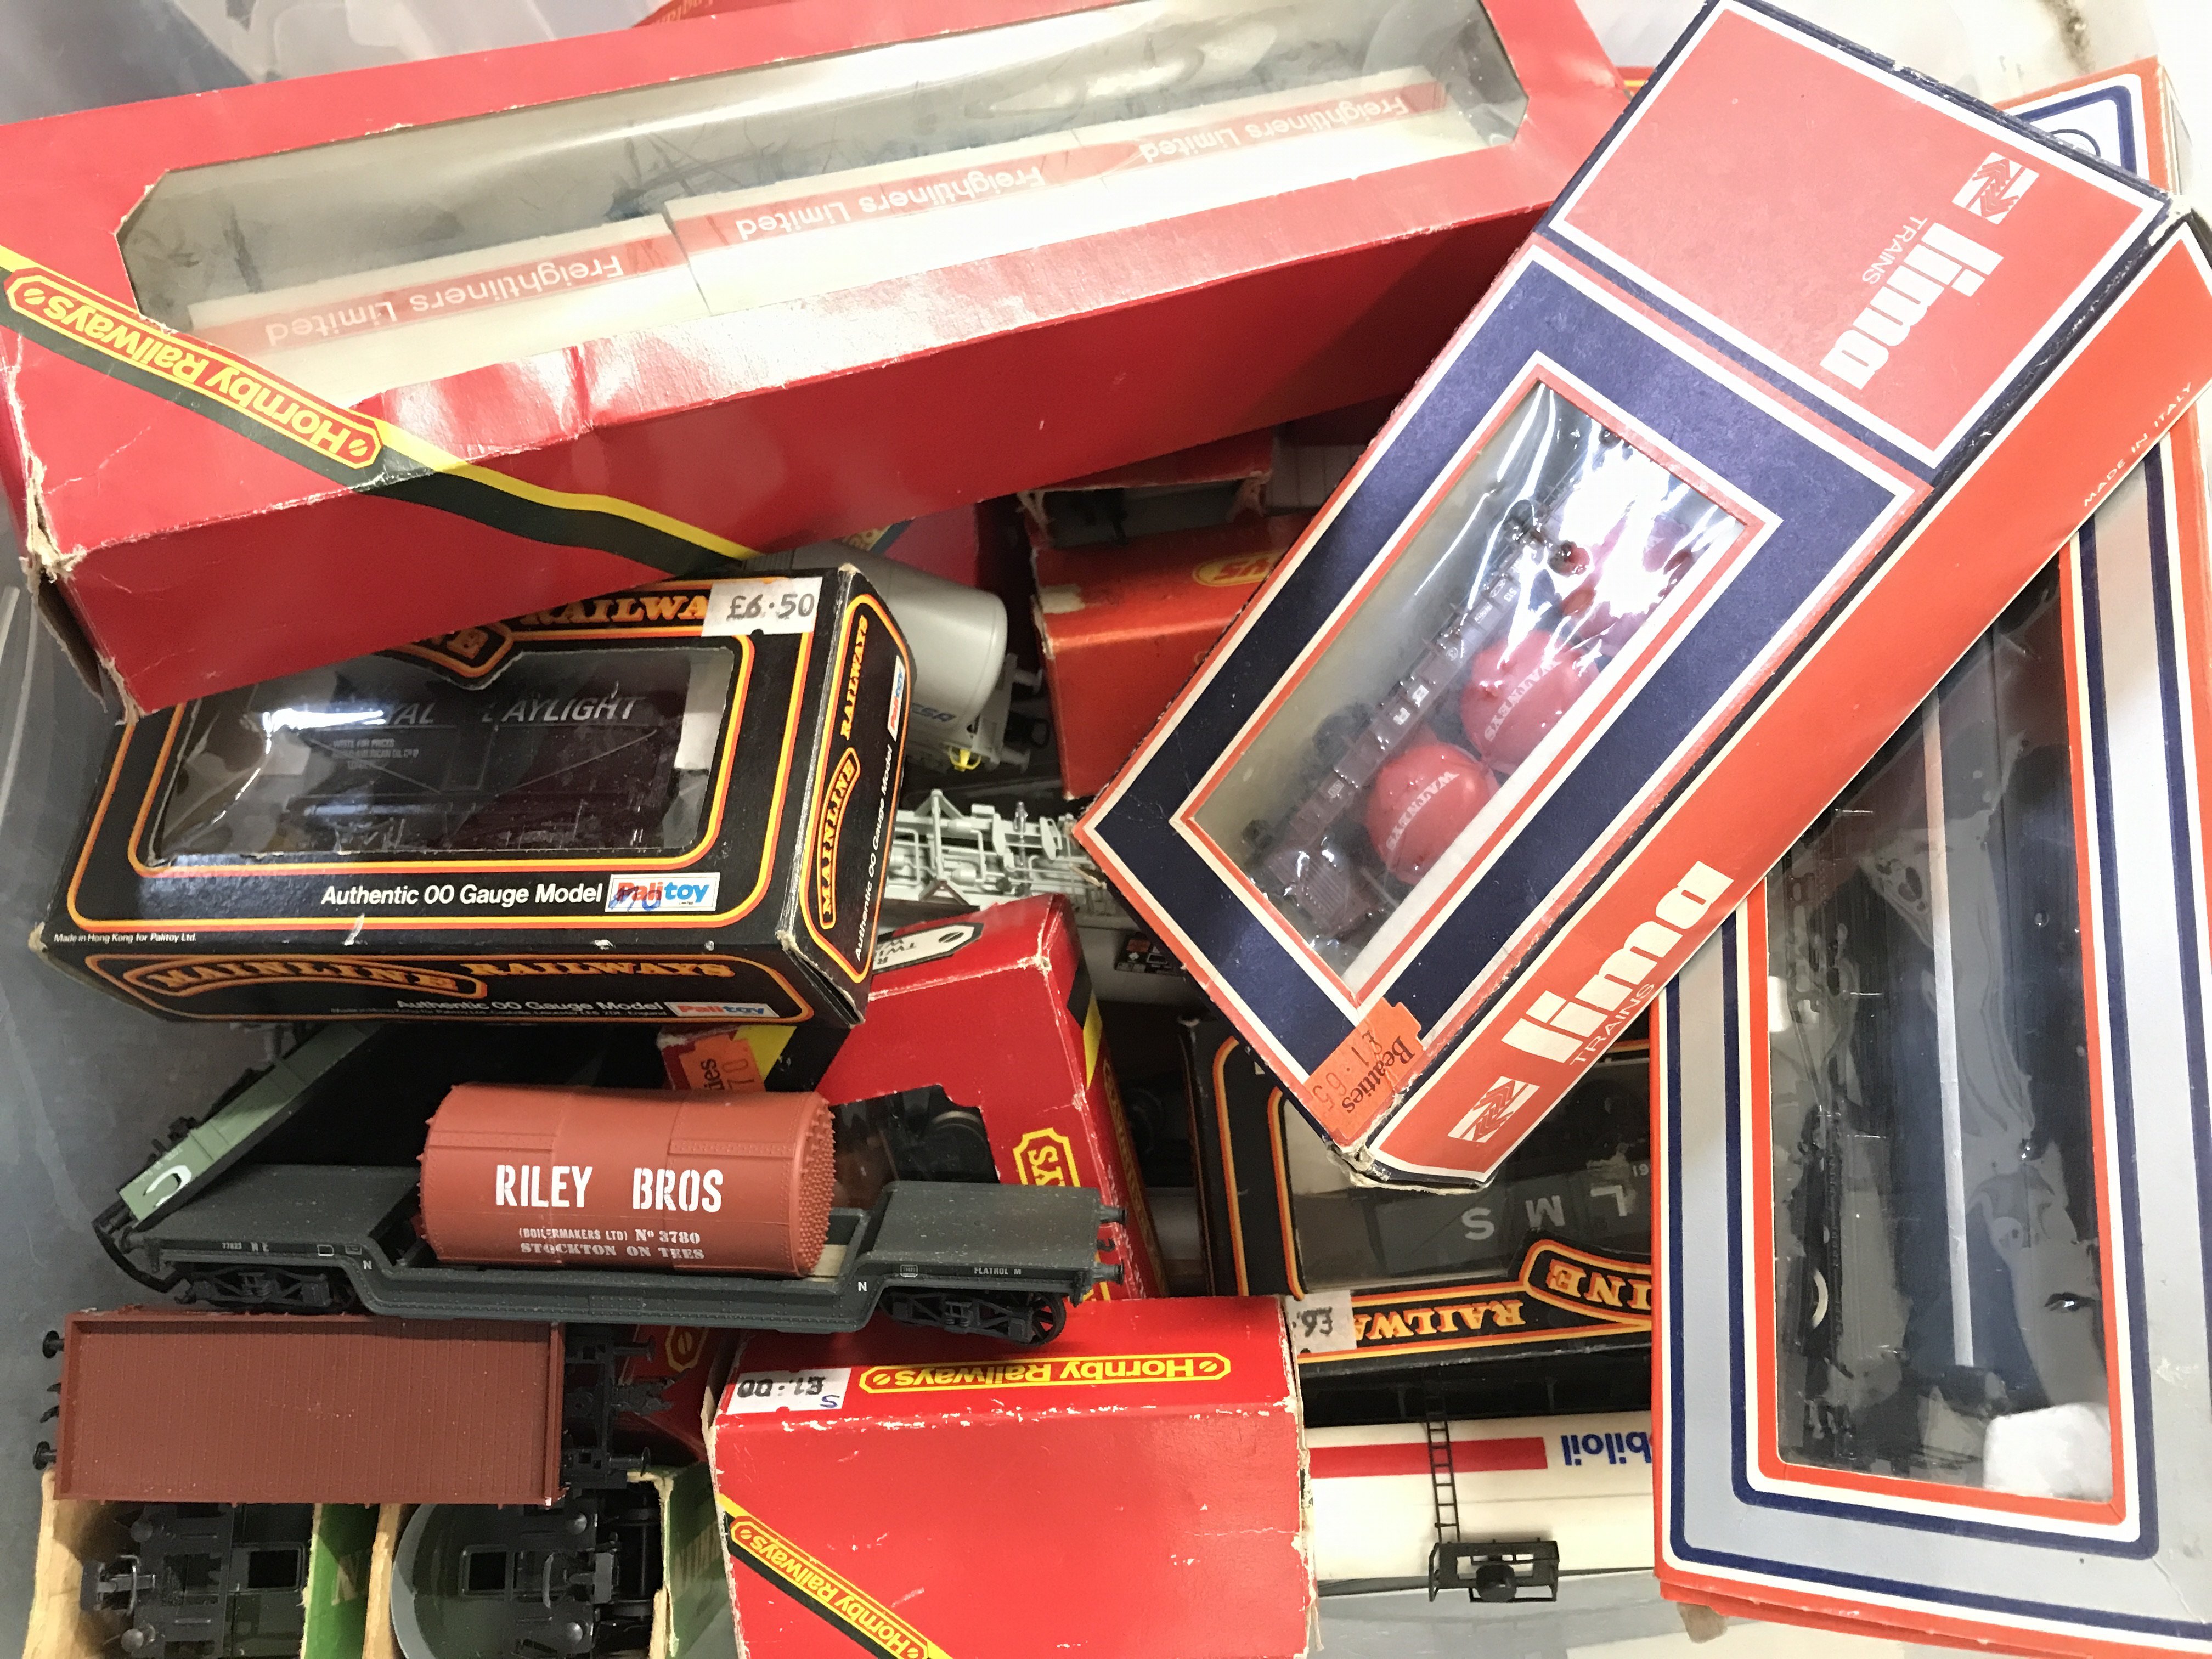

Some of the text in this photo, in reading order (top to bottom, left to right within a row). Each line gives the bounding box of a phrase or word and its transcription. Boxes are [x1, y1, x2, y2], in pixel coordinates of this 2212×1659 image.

[1139, 97, 1409, 163] Freightliners Limited
[736, 166, 1046, 240] Freightliners Limited
[1862, 216, 1928, 285] TRAINS
[265, 255, 624, 346] Freightliners Limited
[1820, 222, 2004, 390] lima
[45, 297, 355, 454] Hornby Railways
[2083, 382, 2192, 507] MADE IN ITALY
[822, 614, 868, 915] MAINLINE RAILWAYS
[1386, 770, 1460, 851] WATNEYS
[855, 881, 873, 962] Authentic
[872, 801, 886, 850] Gauge
[881, 744, 893, 792] Model
[321, 885, 419, 904] Authentic
[459, 885, 531, 907] Gauge
[534, 884, 601, 904] Model
[618, 882, 710, 903] Palitoy
[54, 934, 77, 943] Made
[87, 933, 110, 944] Hong
[111, 933, 133, 944] Kong
[136, 933, 148, 941] for
[150, 933, 179, 943] Palitoy
[181, 933, 197, 941] Ltd.
[1501, 861, 1733, 1063] lima
[147, 961, 736, 991] MAINLINE RAILWAYS
[397, 1000, 489, 1010] Authentic
[525, 1002, 594, 1011] Gauge
[596, 1002, 663, 1010] Model
[678, 1006, 764, 1015] Palitoy
[1569, 983, 1654, 1066] TRAINS
[1342, 1036, 1415, 1113] Beatties
[496, 1164, 724, 1213] RILEY BROS
[363, 1260, 372, 1270] N
[521, 1243, 705, 1259] STOCKTON ON TEES
[606, 1230, 628, 1242] LTD)
[659, 1231, 700, 1244] 3780
[857, 1282, 867, 1292] N
[895, 1358, 1197, 1387] Hornby Railways
[751, 1536, 840, 1602] Railways
[834, 1599, 911, 1652] Hornby
